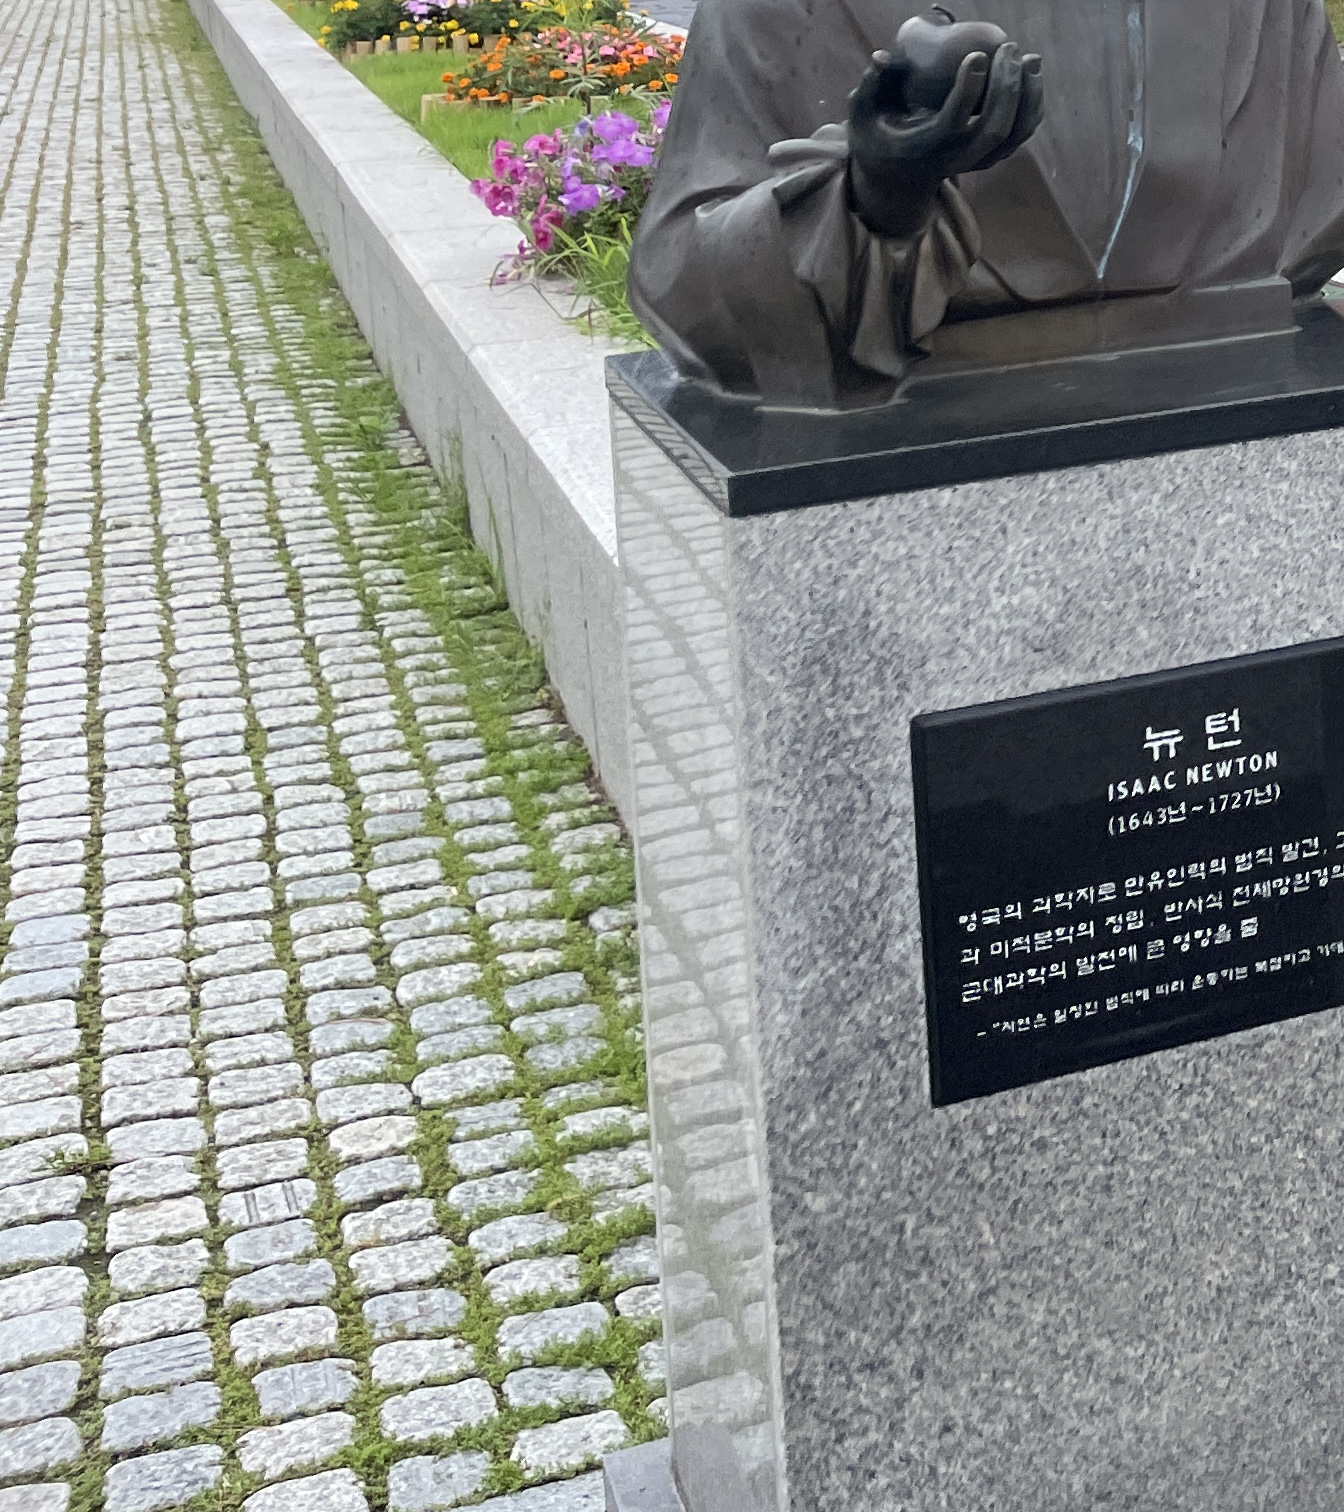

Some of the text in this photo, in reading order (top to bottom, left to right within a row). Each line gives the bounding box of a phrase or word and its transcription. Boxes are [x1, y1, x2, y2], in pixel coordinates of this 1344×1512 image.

[1143, 707, 1242, 762] 뉴 턴
[1108, 750, 1278, 802] ISAAC NEWTON
[959, 901, 1022, 932] 영국의
[1032, 882, 1117, 914] 과학자로
[1124, 856, 1227, 897] 만유인력의
[1235, 846, 1273, 873] 법칙
[960, 947, 980, 965] 과
[990, 920, 1095, 959] 미적분학의
[1164, 890, 1223, 922] 반사식
[961, 960, 1067, 1003] 근대과학의
[1076, 944, 1138, 976] 발전에
[1172, 923, 1232, 952] 영향을
